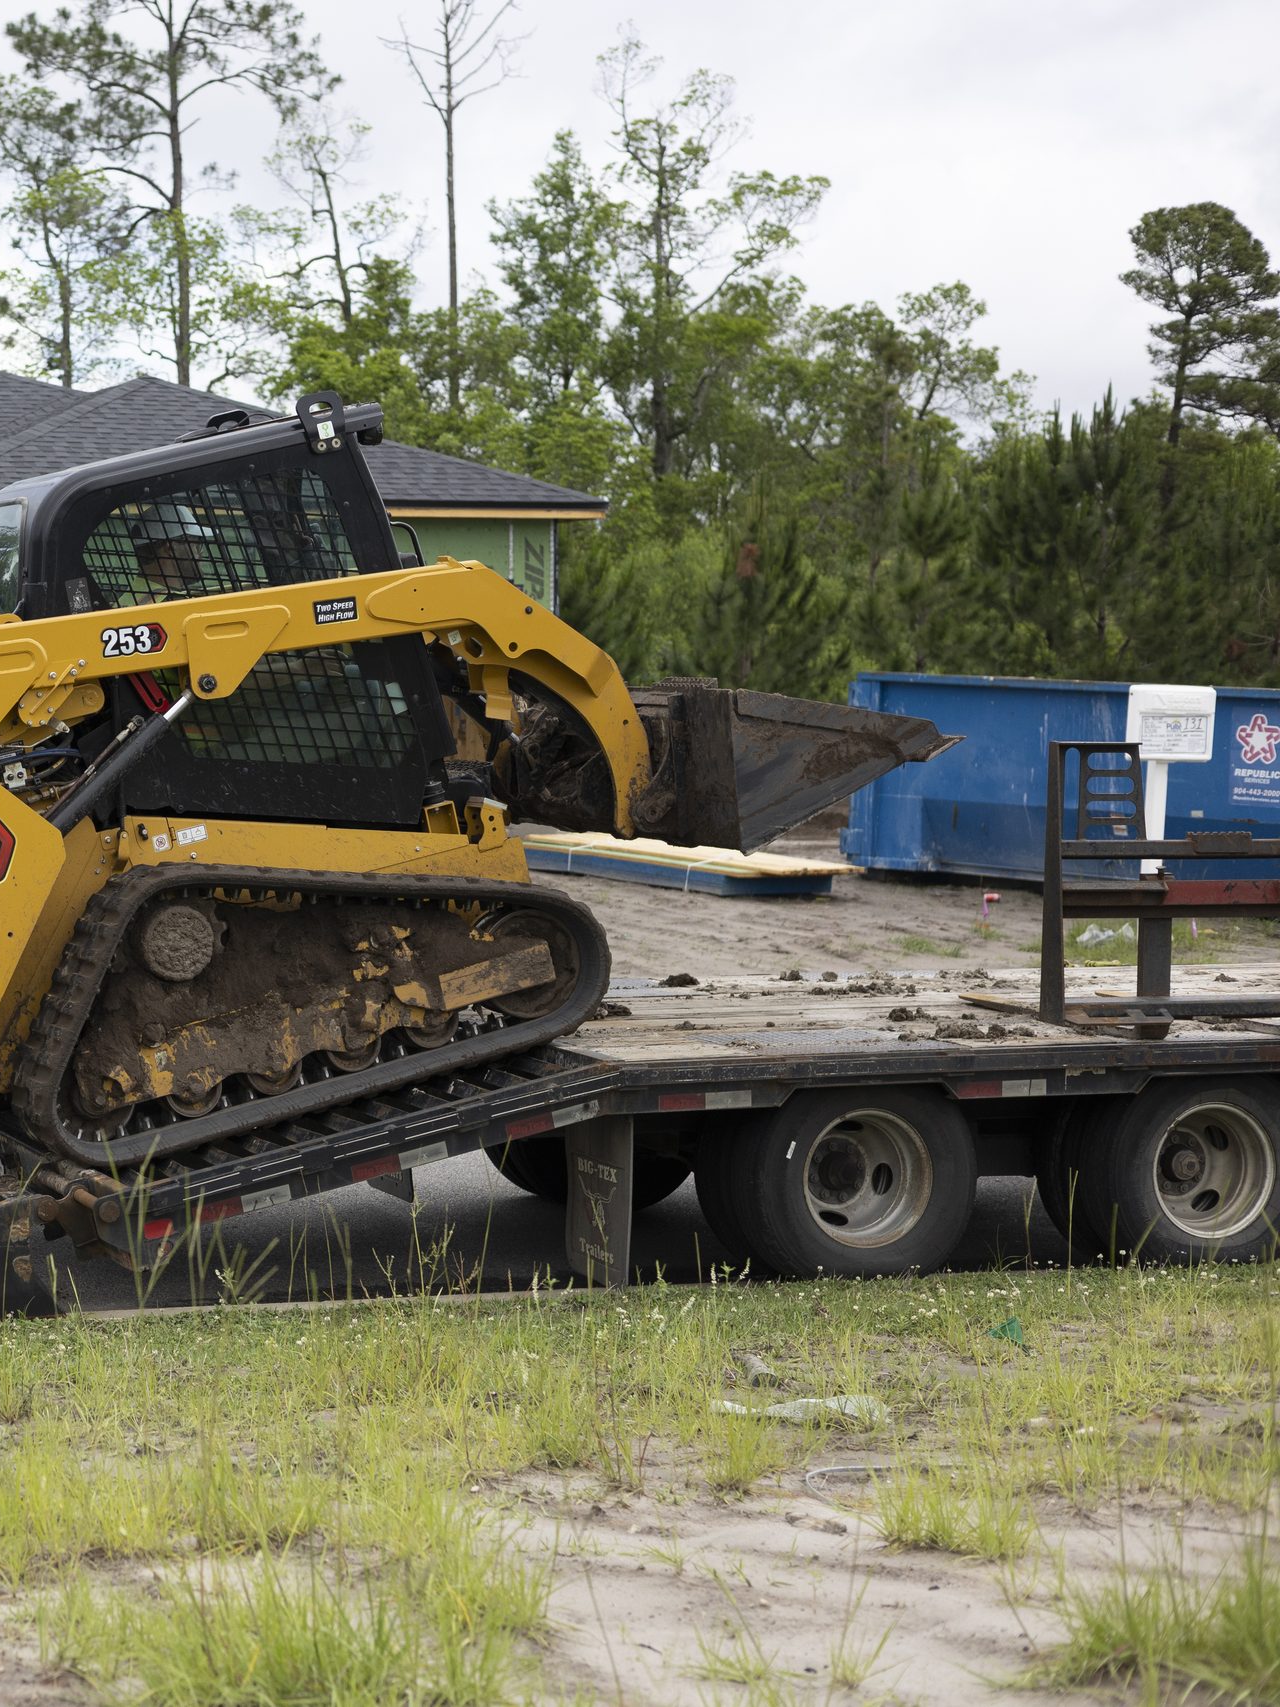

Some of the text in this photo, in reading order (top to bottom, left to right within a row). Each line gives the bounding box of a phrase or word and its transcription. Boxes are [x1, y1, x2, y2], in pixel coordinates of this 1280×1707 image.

[524, 537, 544, 599] ZIP
[316, 602, 354, 612] TWO SPEED
[318, 611, 355, 622] HIGH FLOW
[102, 625, 151, 656] 253
[1184, 717, 1202, 730] 131
[1234, 768, 1280, 779] REPUBLIC
[578, 1157, 617, 1183] BIG-TEX
[579, 1237, 614, 1264] Trailers
